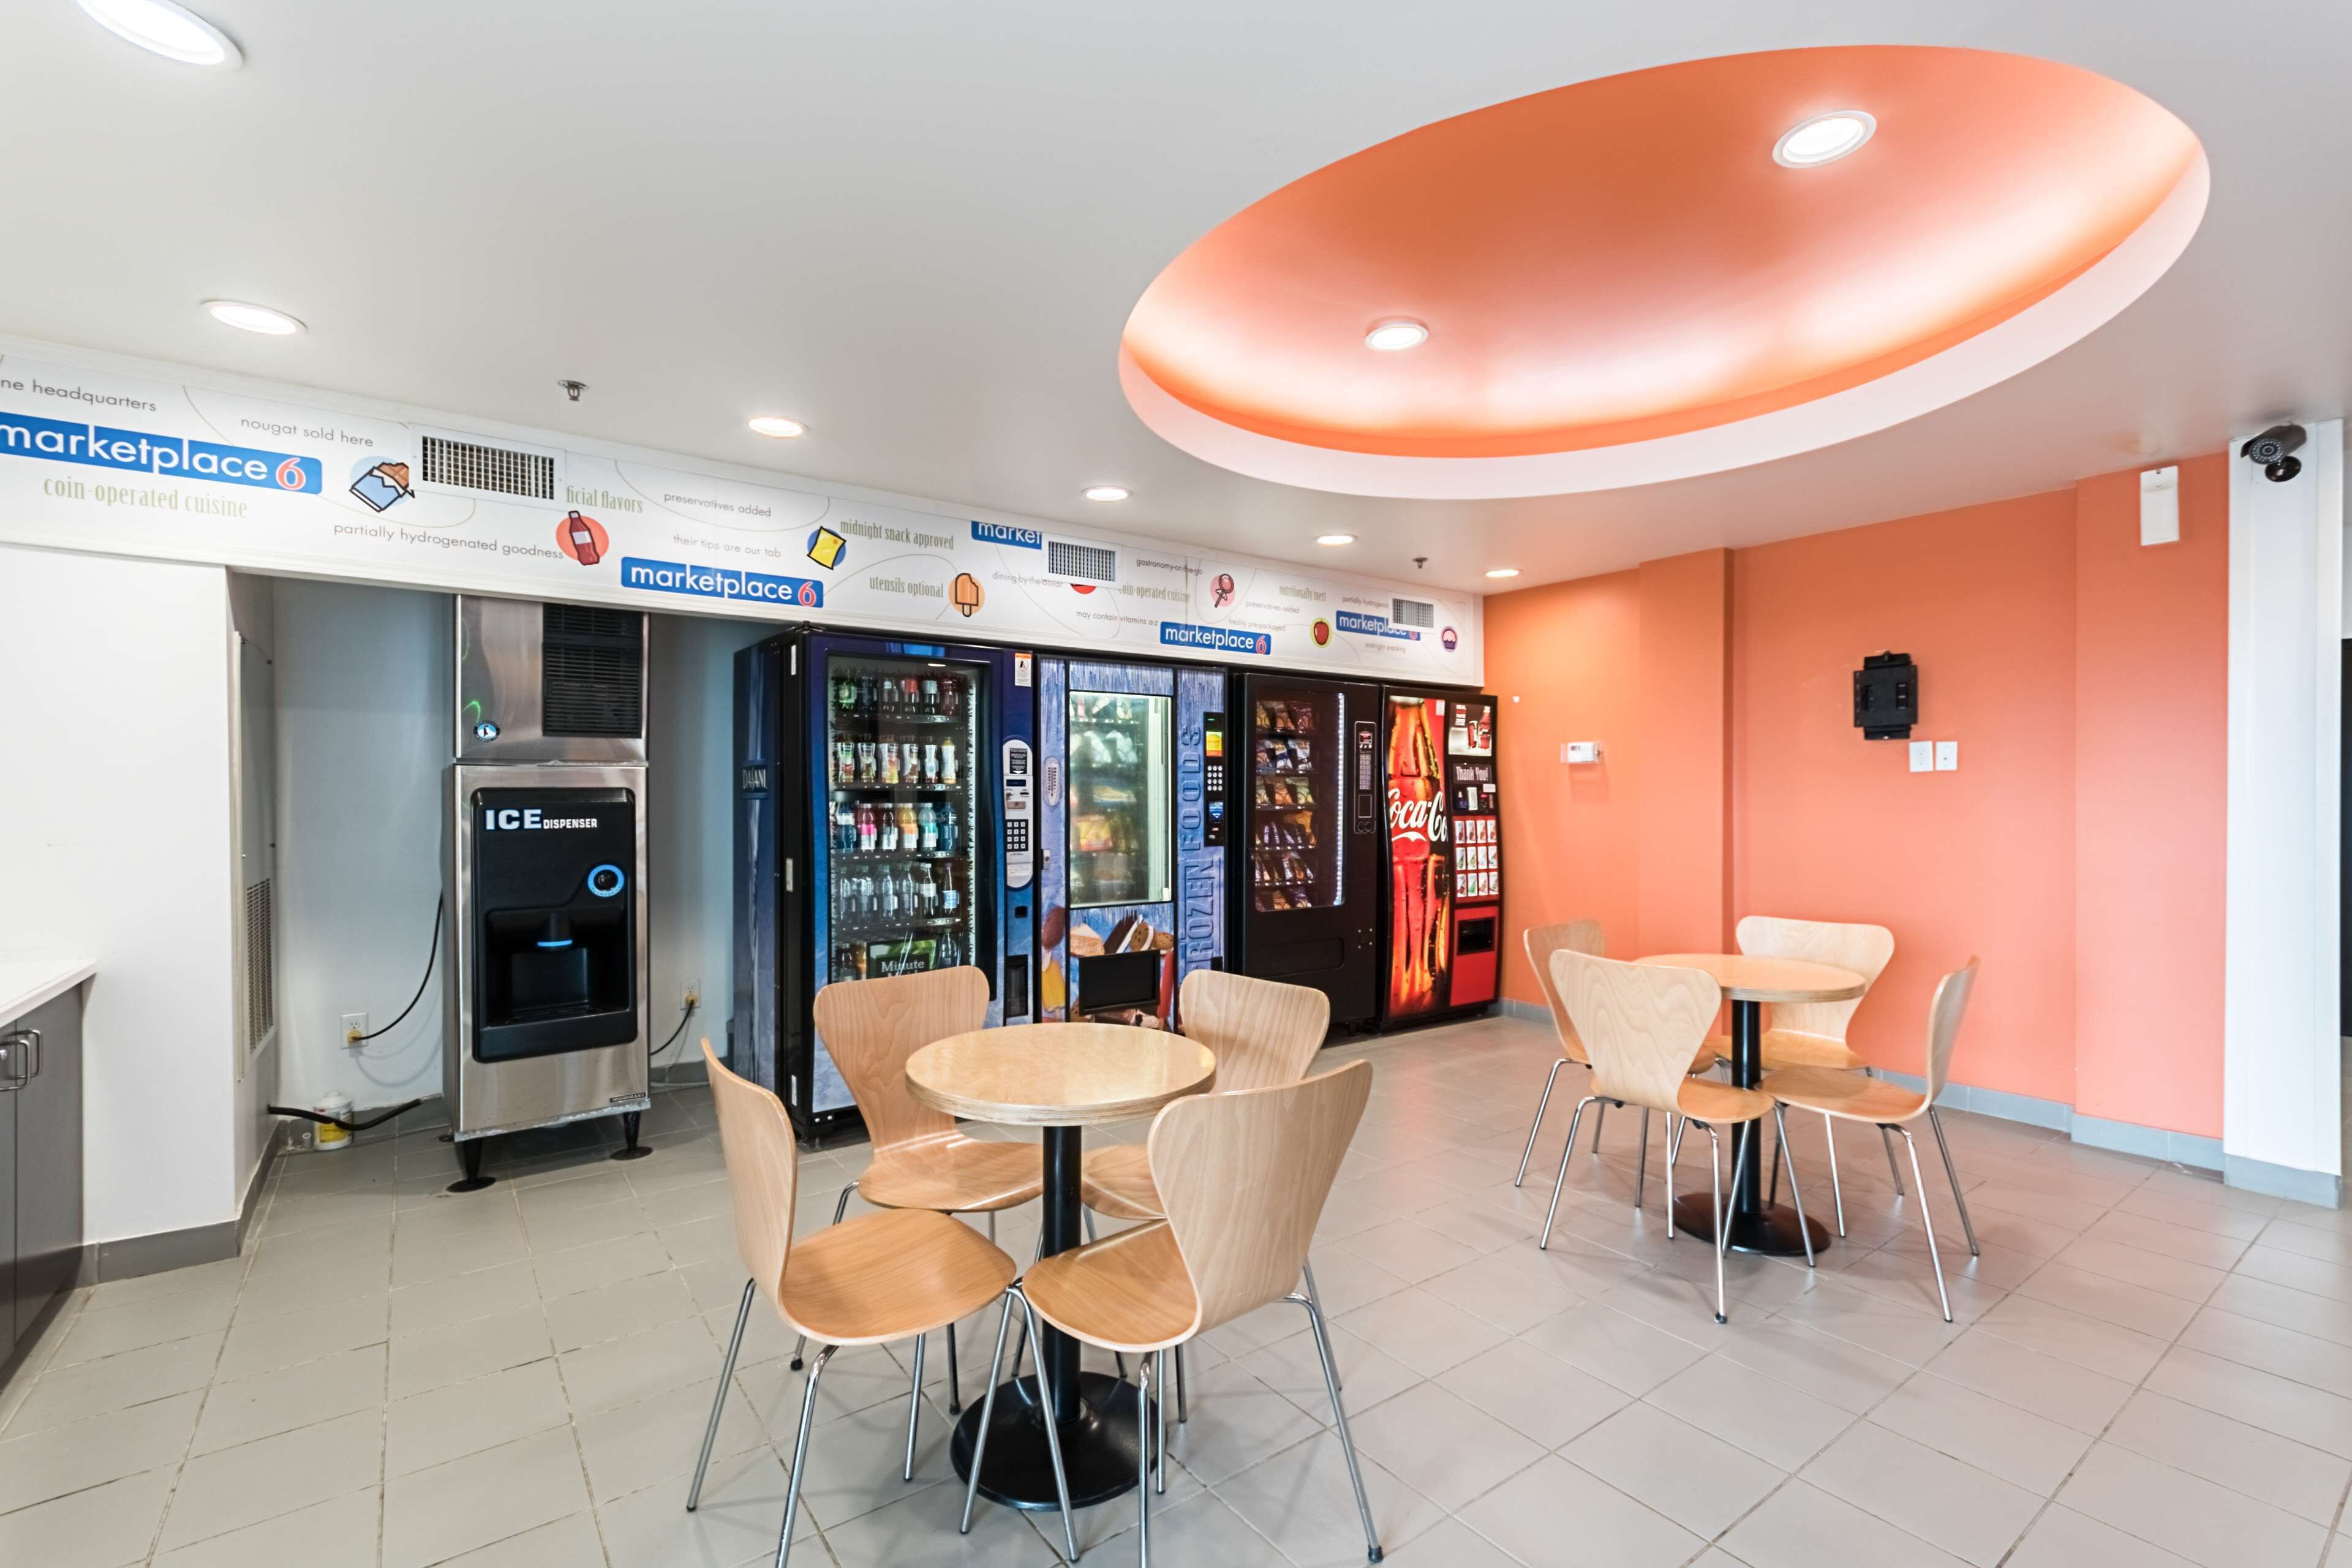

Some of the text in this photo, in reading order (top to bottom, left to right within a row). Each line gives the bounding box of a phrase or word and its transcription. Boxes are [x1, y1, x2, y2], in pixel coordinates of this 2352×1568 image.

[32, 379, 157, 412] headquarters
[241, 418, 374, 448] nougat sold here
[0, 424, 307, 491] marketplace 6
[43, 475, 248, 518] coin-operated cuisine
[601, 490, 643, 513] flavors
[663, 492, 772, 518] preservatives added
[334, 522, 564, 560] partially hydrogenated goodness
[673, 534, 782, 559] their tips are our tab
[840, 519, 955, 550] midnight snack approved
[630, 564, 817, 608] marketplace 6
[869, 576, 944, 598] utensils optional
[1167, 588, 1191, 603] cuisine
[1076, 611, 1091, 620] may
[1093, 612, 1118, 622] contain
[1119, 615, 1147, 625] vitamins
[1165, 625, 1267, 655] marketplace 6
[1456, 766, 1475, 781] Thank
[485, 809, 598, 830] ICE DISPENSER
[1186, 858, 1213, 970] ROZEN
[880, 959, 925, 973] Minute
